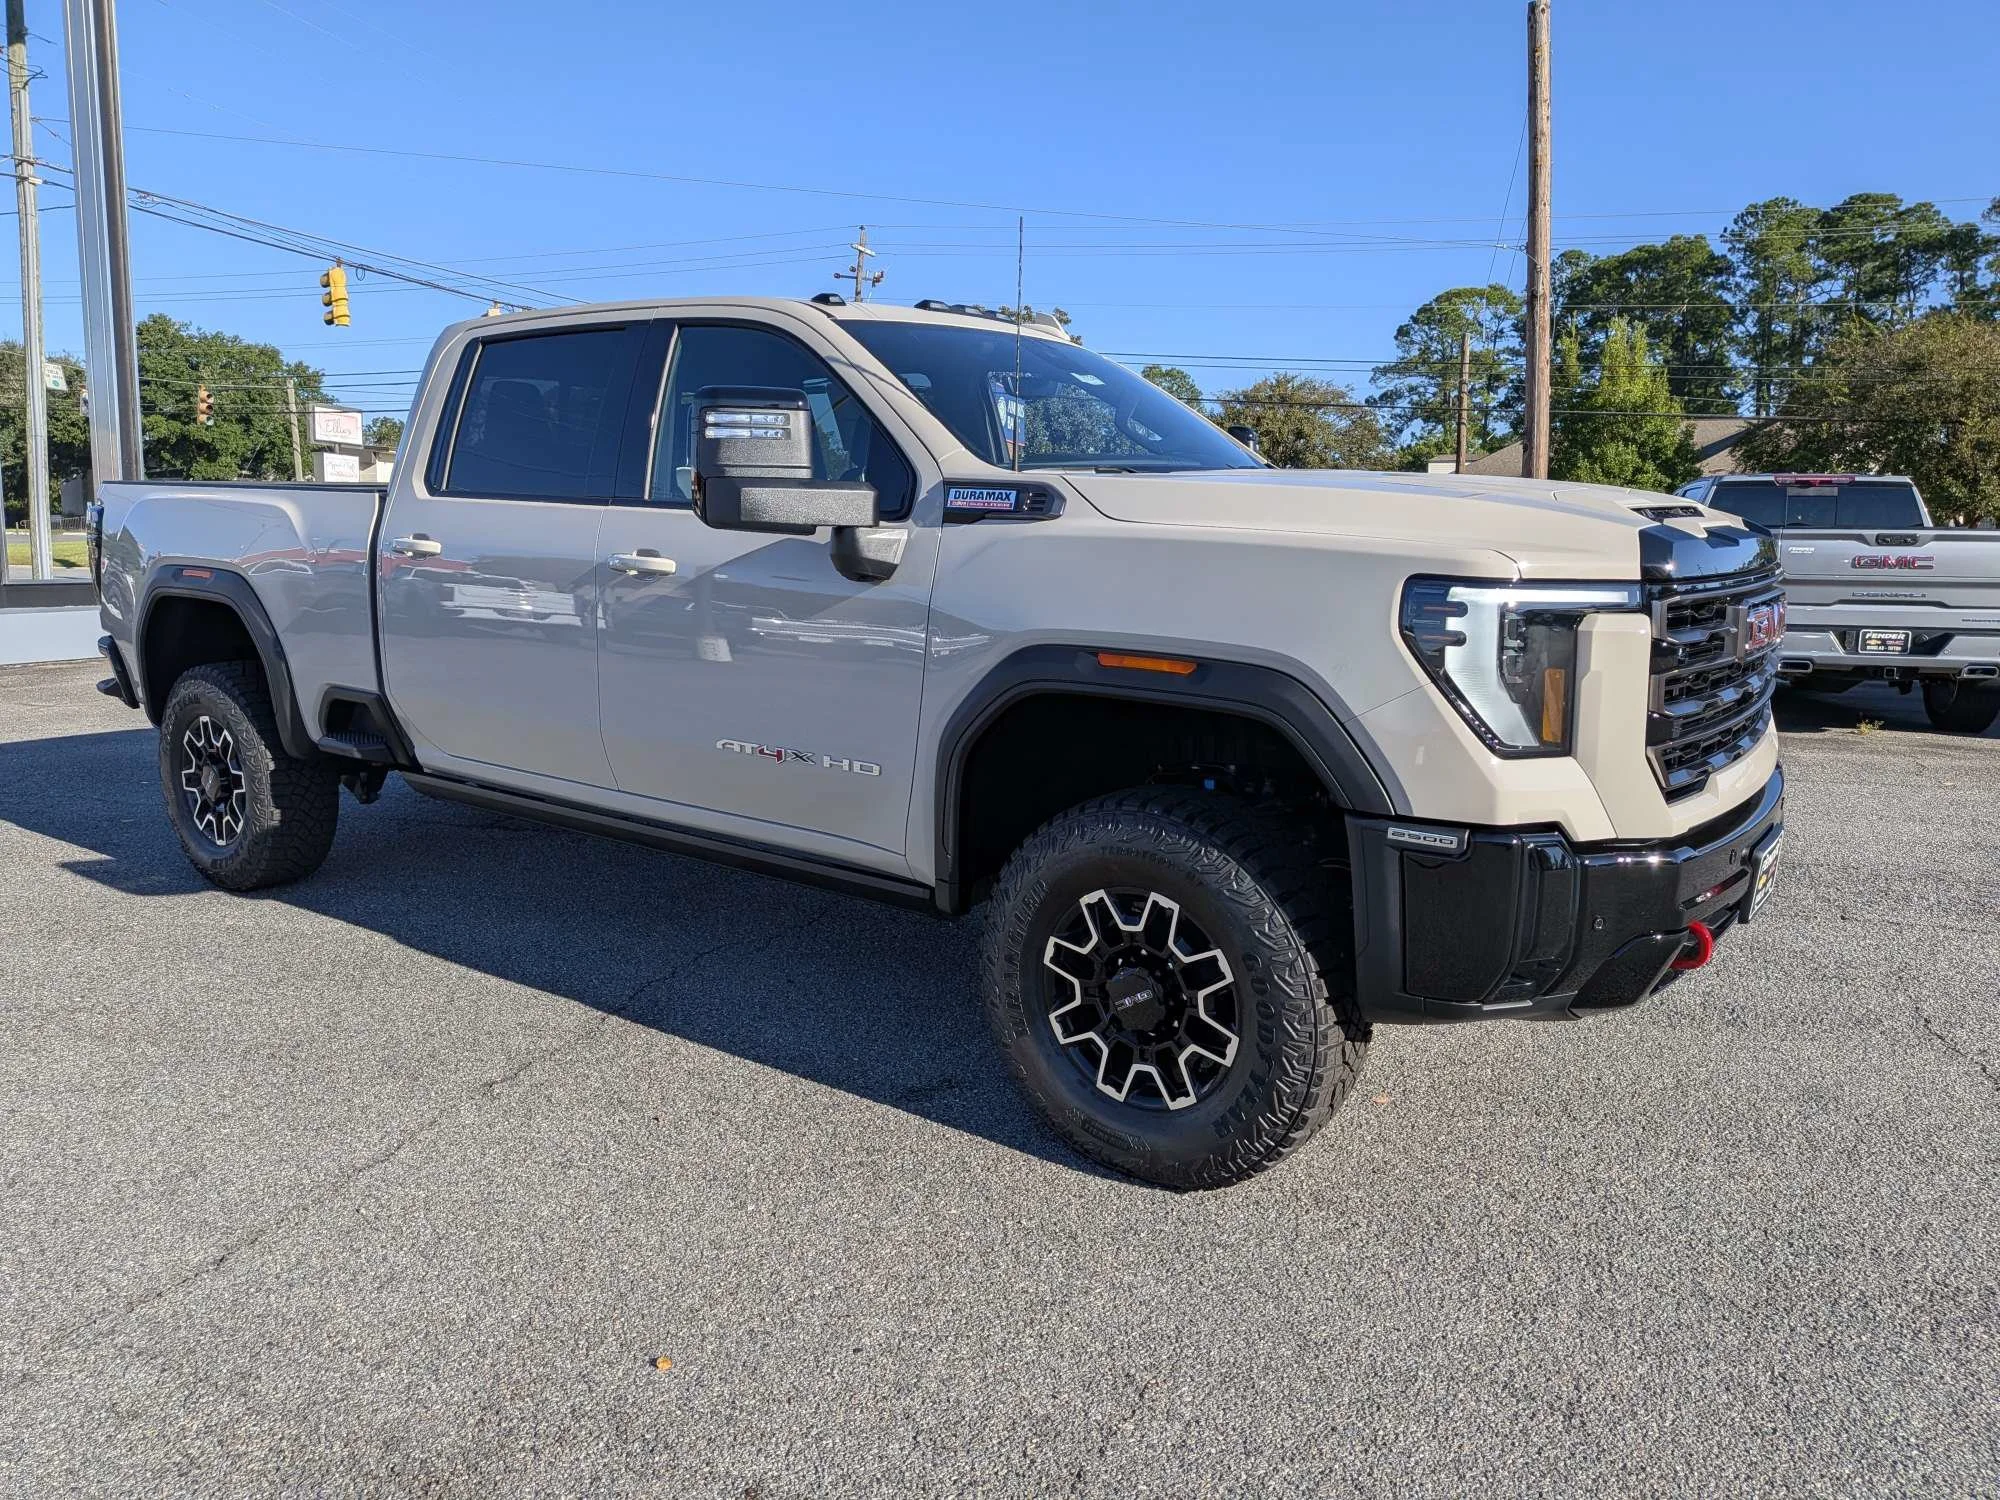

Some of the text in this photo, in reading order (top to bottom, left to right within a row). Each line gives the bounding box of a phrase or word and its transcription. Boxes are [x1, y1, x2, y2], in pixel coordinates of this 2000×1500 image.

[953, 490, 1012, 501] DURAMAX
[1851, 554, 1935, 569] GMC
[1865, 632, 1906, 640] FENDER
[716, 739, 881, 776] AT4X HD
[1391, 829, 1454, 846] 2500
